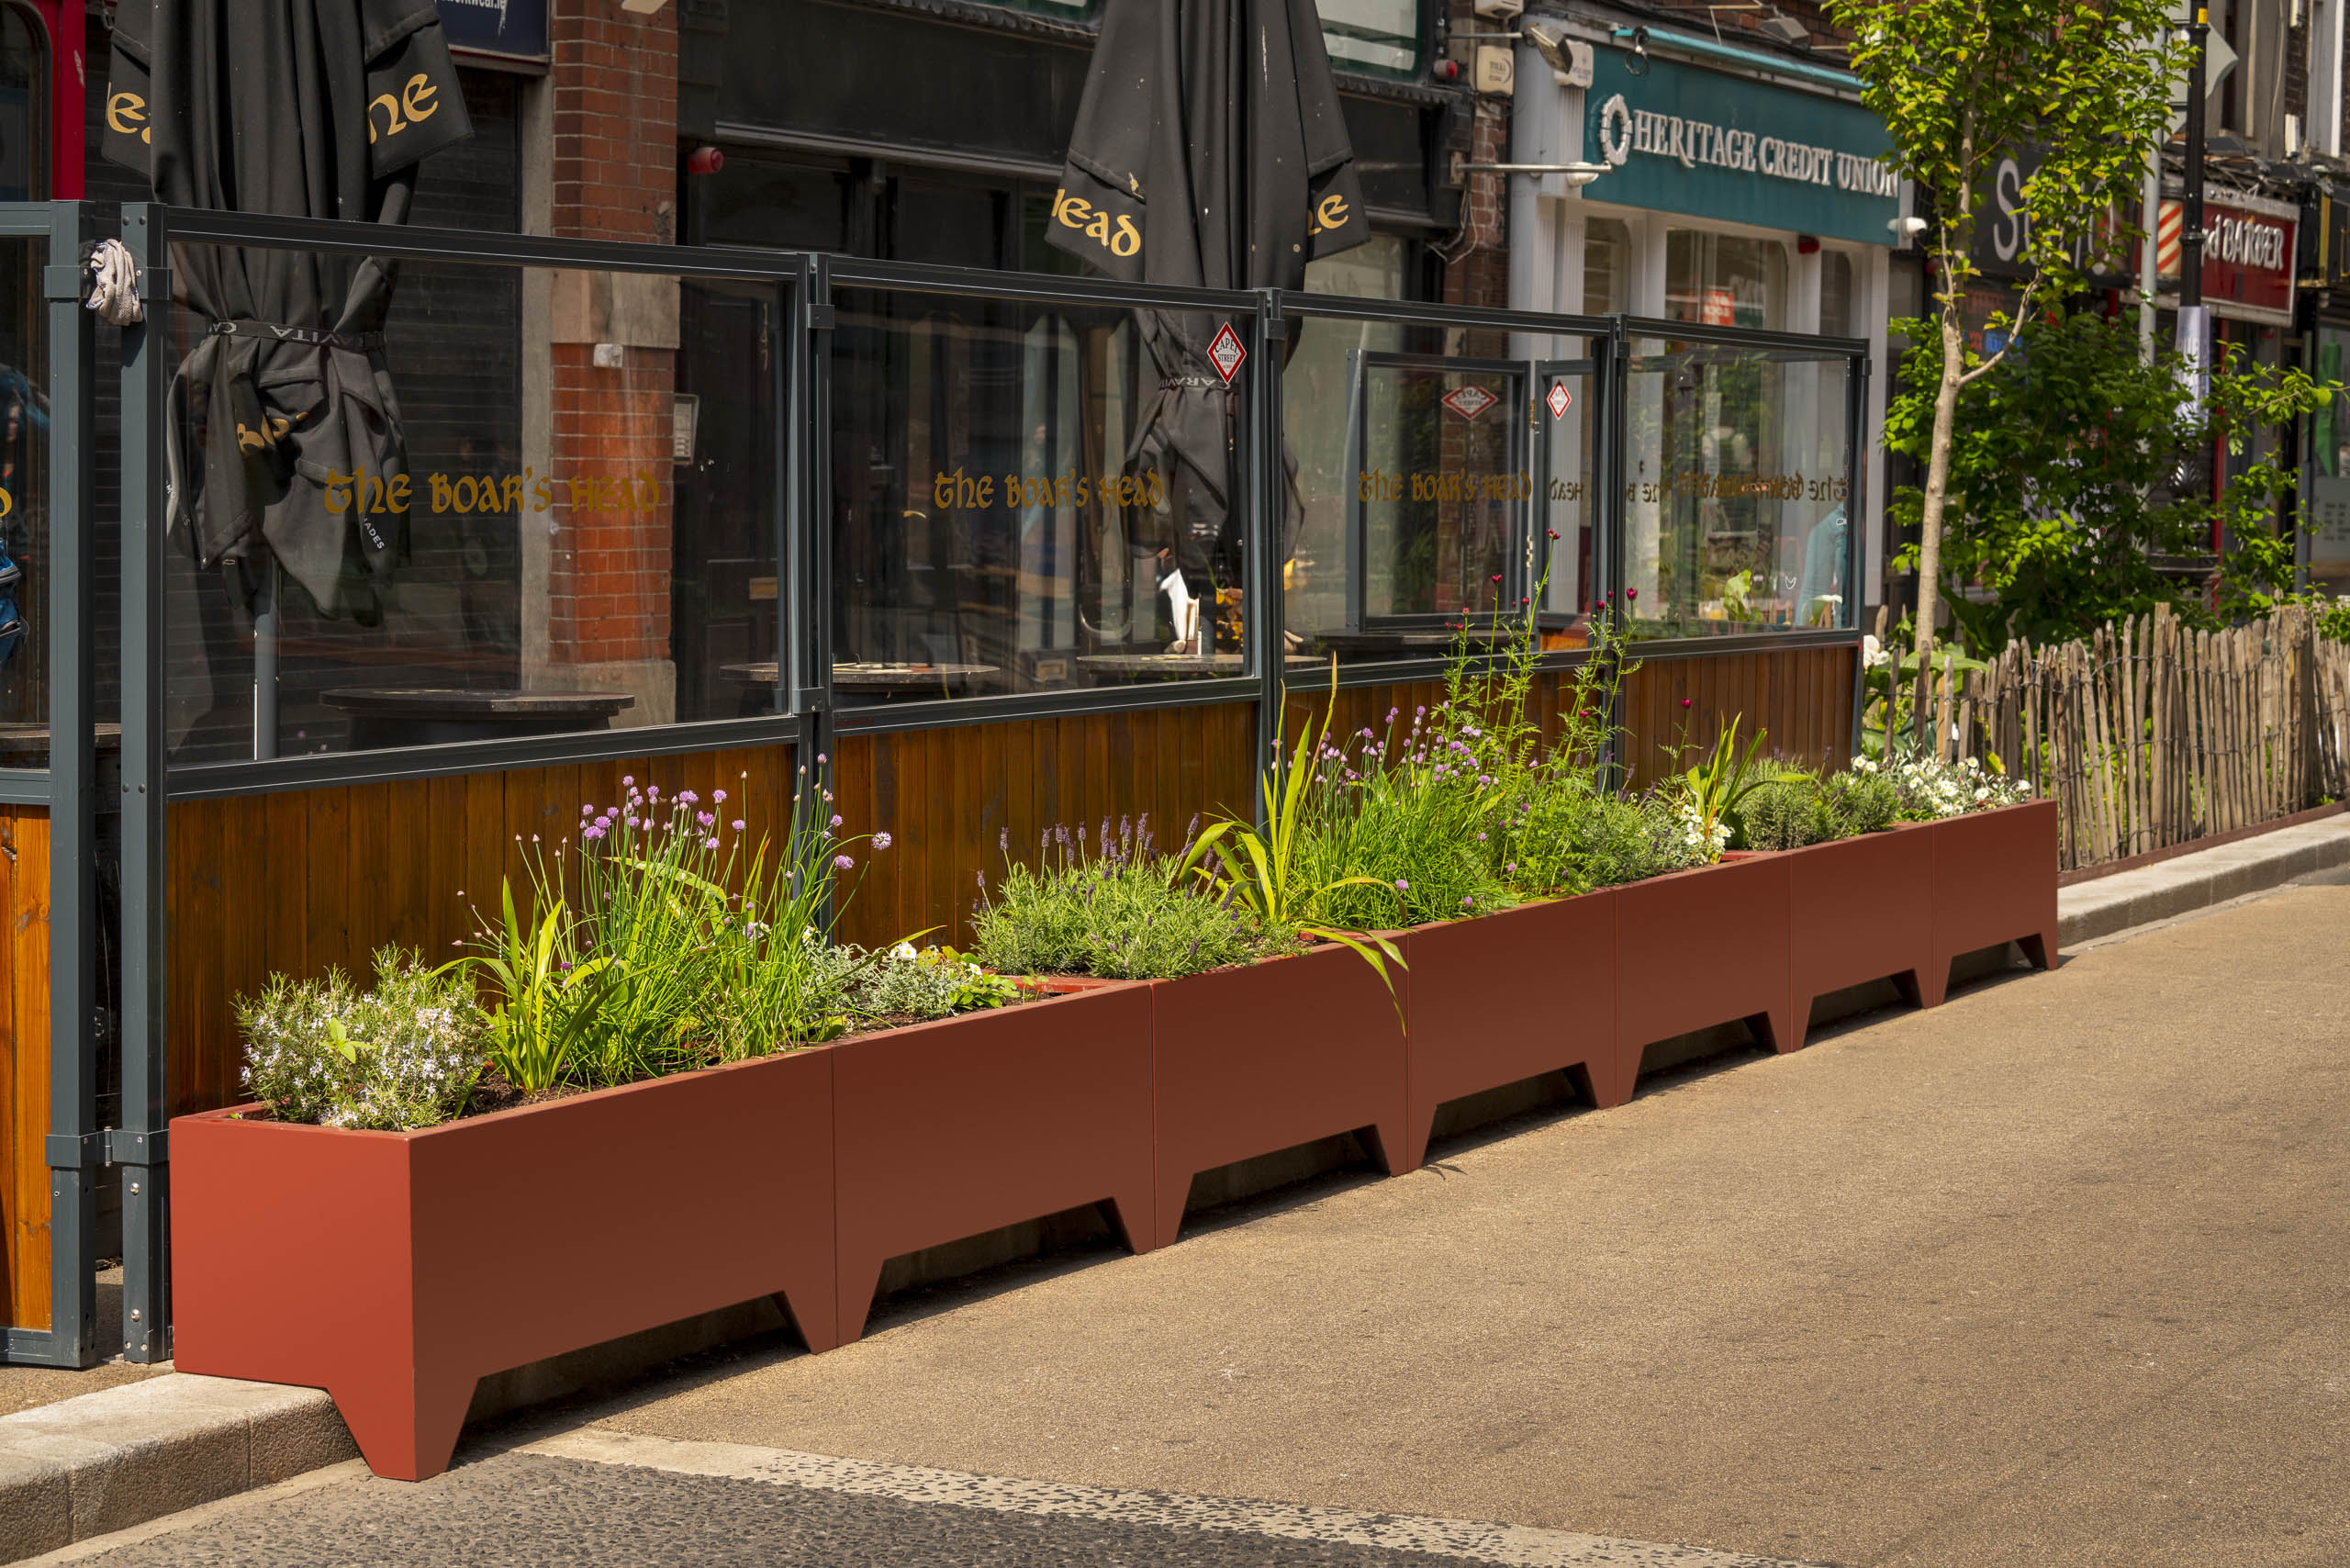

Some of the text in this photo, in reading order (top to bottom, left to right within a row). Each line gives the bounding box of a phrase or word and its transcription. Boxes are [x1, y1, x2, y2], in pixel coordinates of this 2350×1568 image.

[1632, 109, 1898, 197] HERITAGE CREDIT UNION
[2222, 218, 2284, 271] BARBER
[1214, 337, 1239, 355] CAPEL
[1217, 353, 1237, 363] STREET
